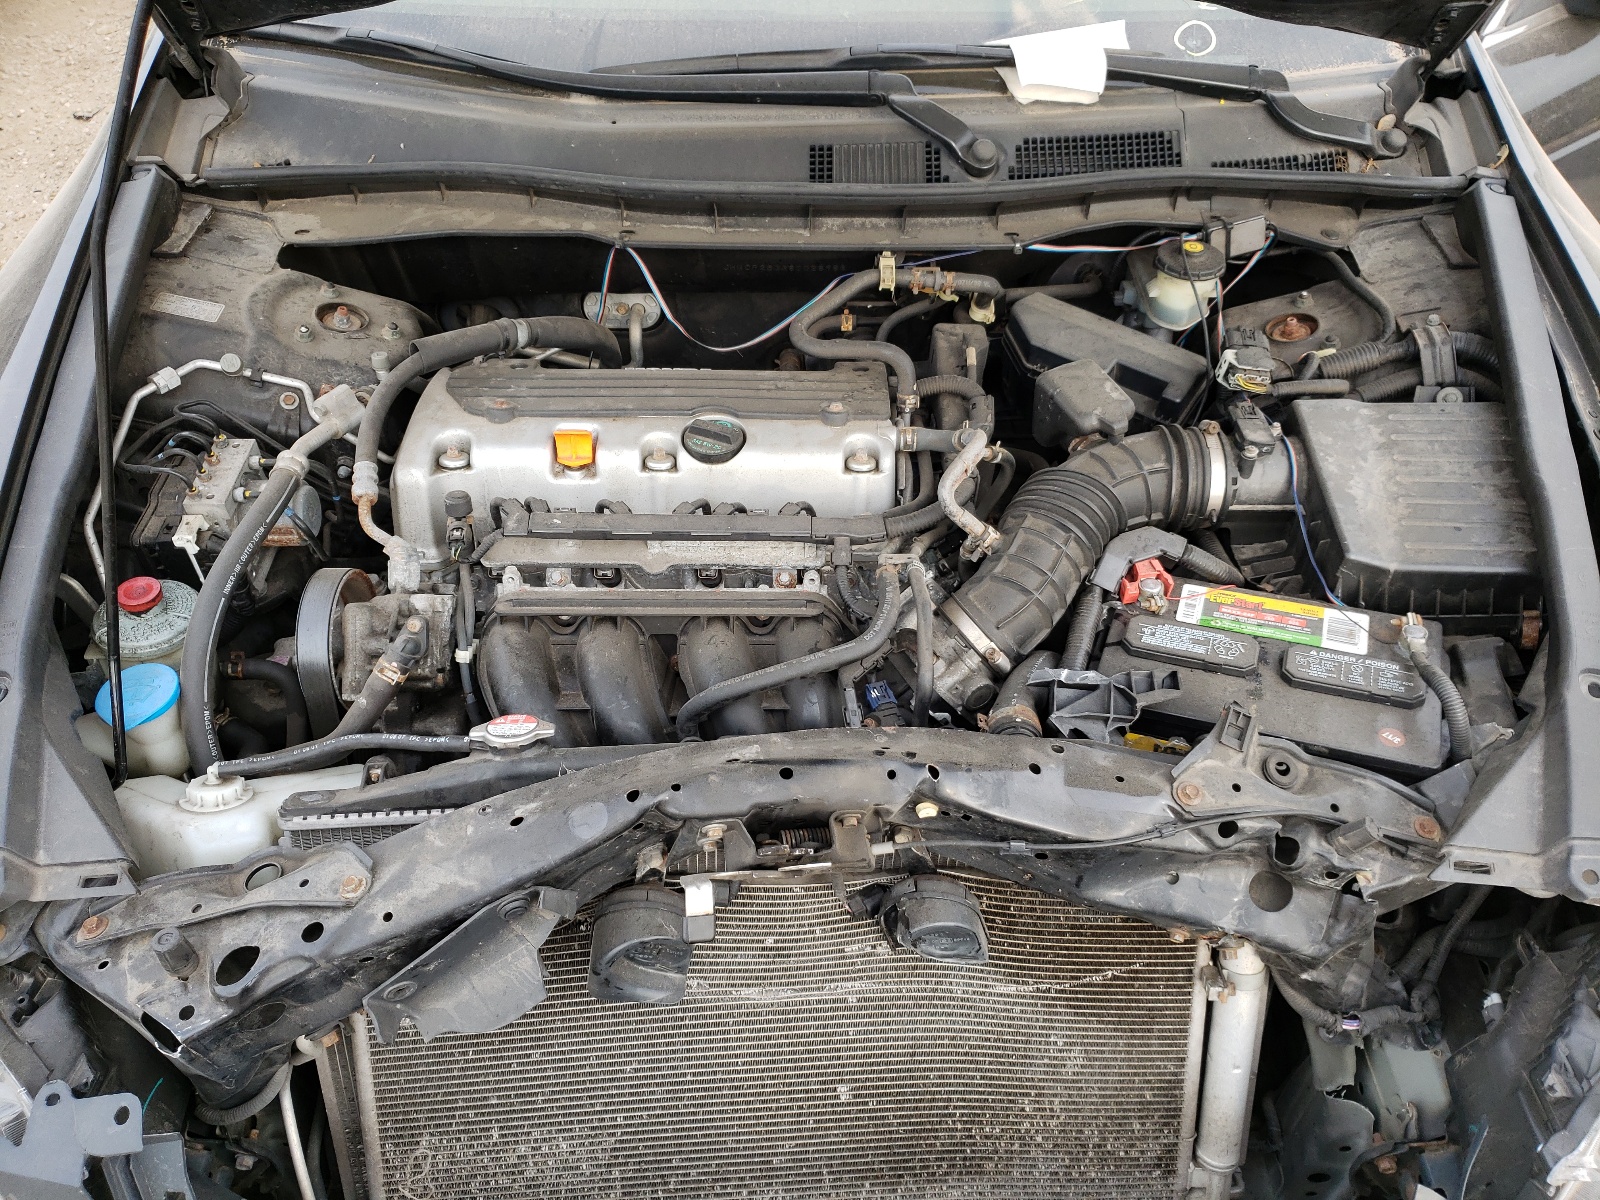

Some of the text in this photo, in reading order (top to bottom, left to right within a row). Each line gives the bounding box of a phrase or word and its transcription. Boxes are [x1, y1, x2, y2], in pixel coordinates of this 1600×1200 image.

[1210, 594, 1264, 610] EverStart
[1319, 651, 1356, 663] DANGER
[1365, 659, 1399, 671] POISON
[1382, 731, 1402, 744] 3/17
